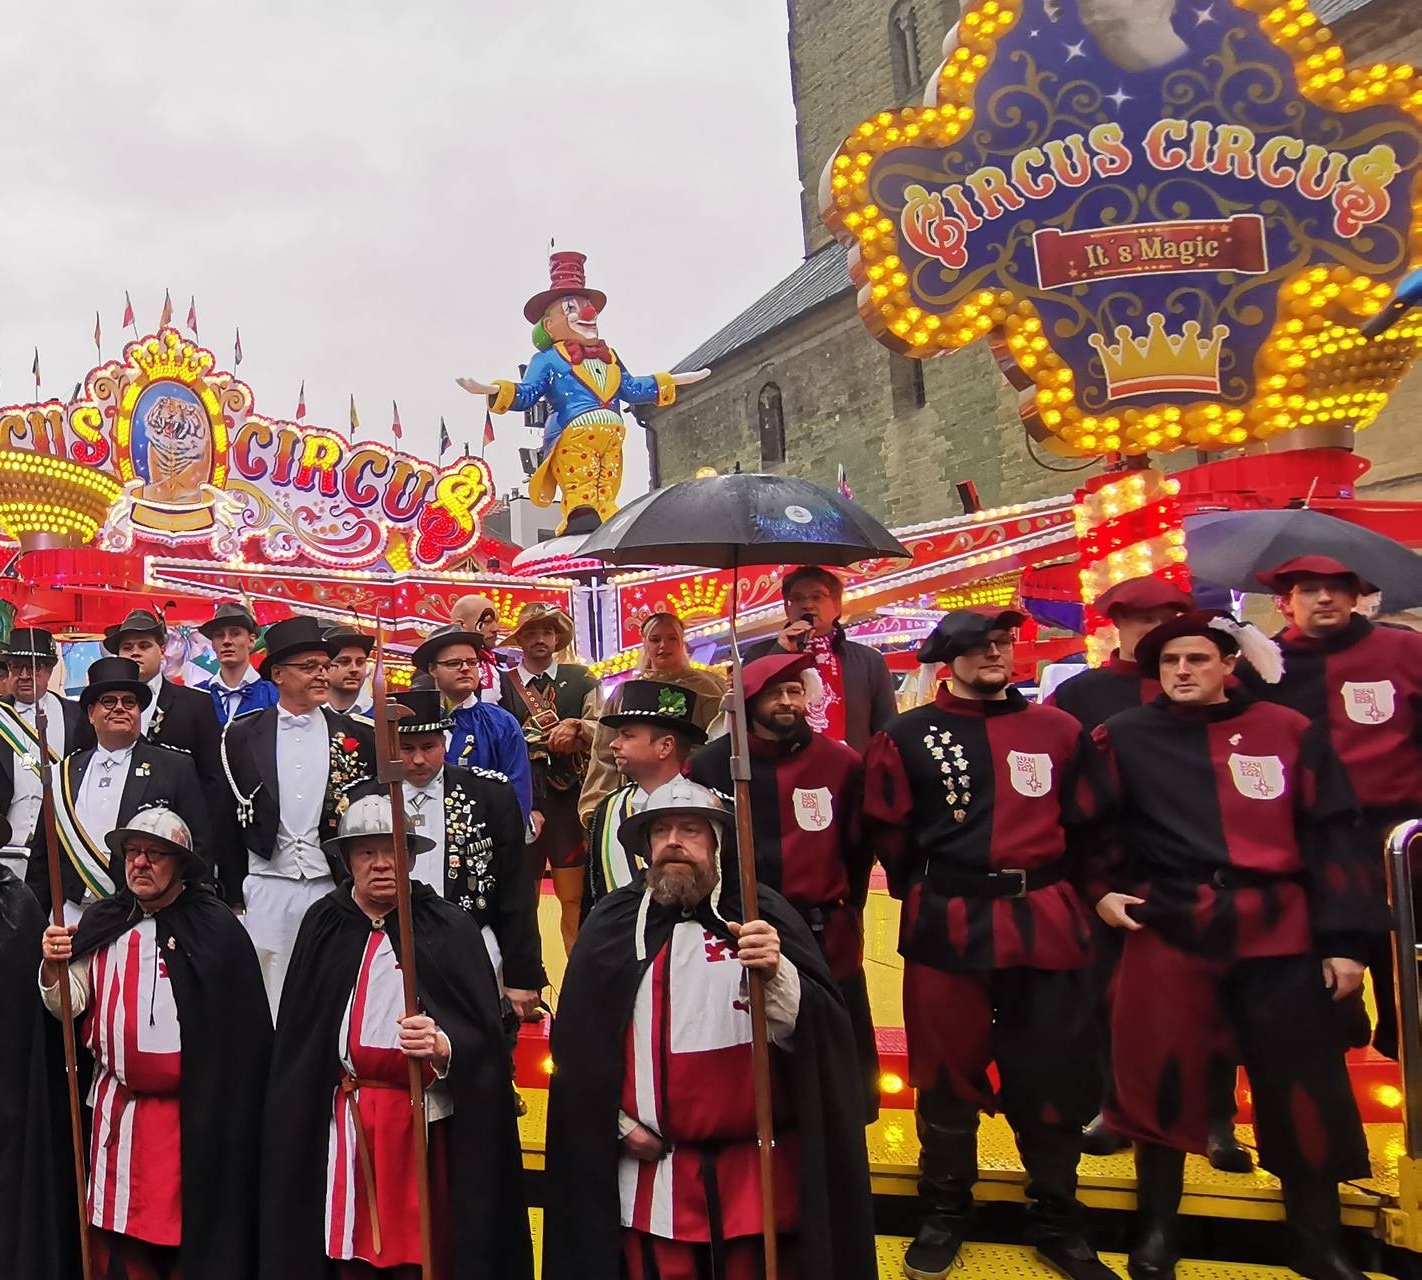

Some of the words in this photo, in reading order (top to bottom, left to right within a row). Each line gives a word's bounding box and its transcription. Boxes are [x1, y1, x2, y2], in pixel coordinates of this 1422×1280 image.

[900, 121, 1133, 270] CIRCUS
[1141, 118, 1402, 239] CIRCUS
[1138, 235, 1220, 266] Magic
[232, 421, 486, 564] CIRCUS
